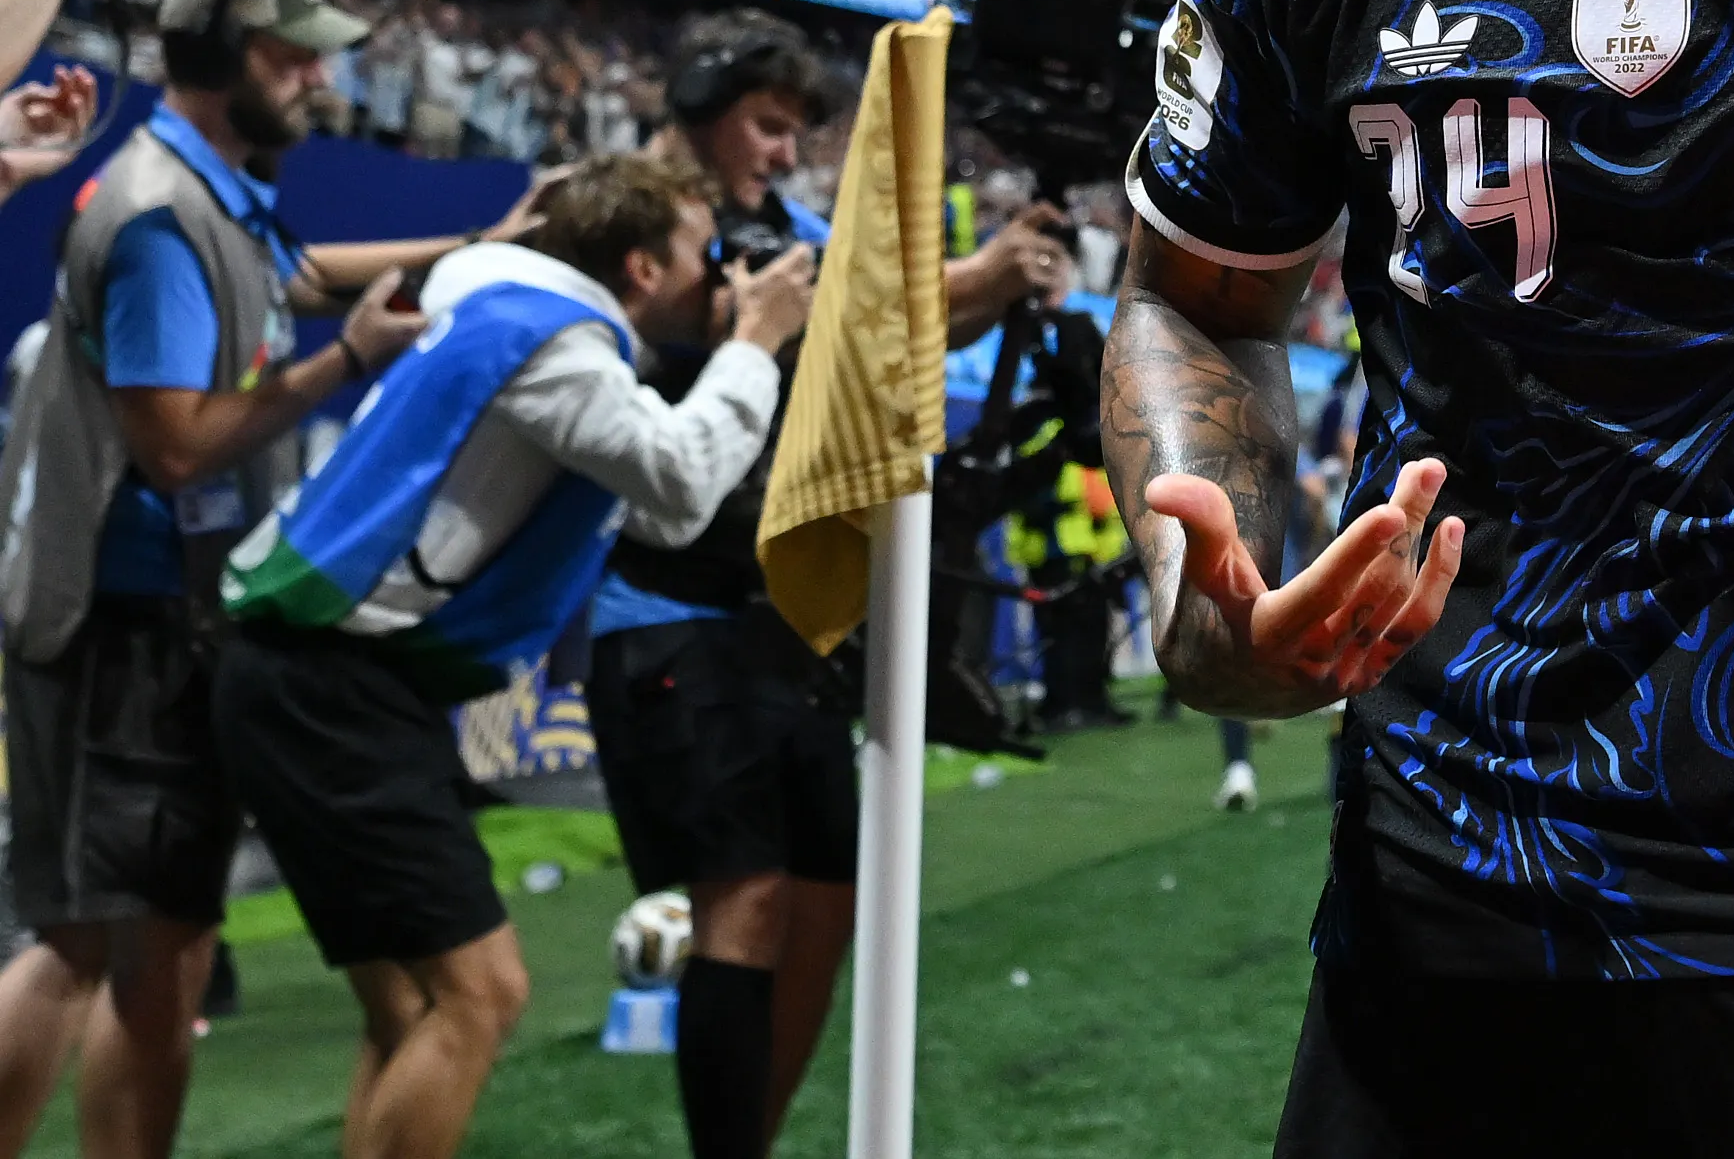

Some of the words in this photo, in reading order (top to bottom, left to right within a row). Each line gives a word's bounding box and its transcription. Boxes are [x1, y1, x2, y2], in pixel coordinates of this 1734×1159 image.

[1606, 36, 1656, 54] FIFA
[1622, 53, 1668, 61] CHAMPIONS
[1614, 63, 1645, 73] 2022
[1180, 103, 1193, 116] CUP
[1161, 104, 1190, 130] 026
